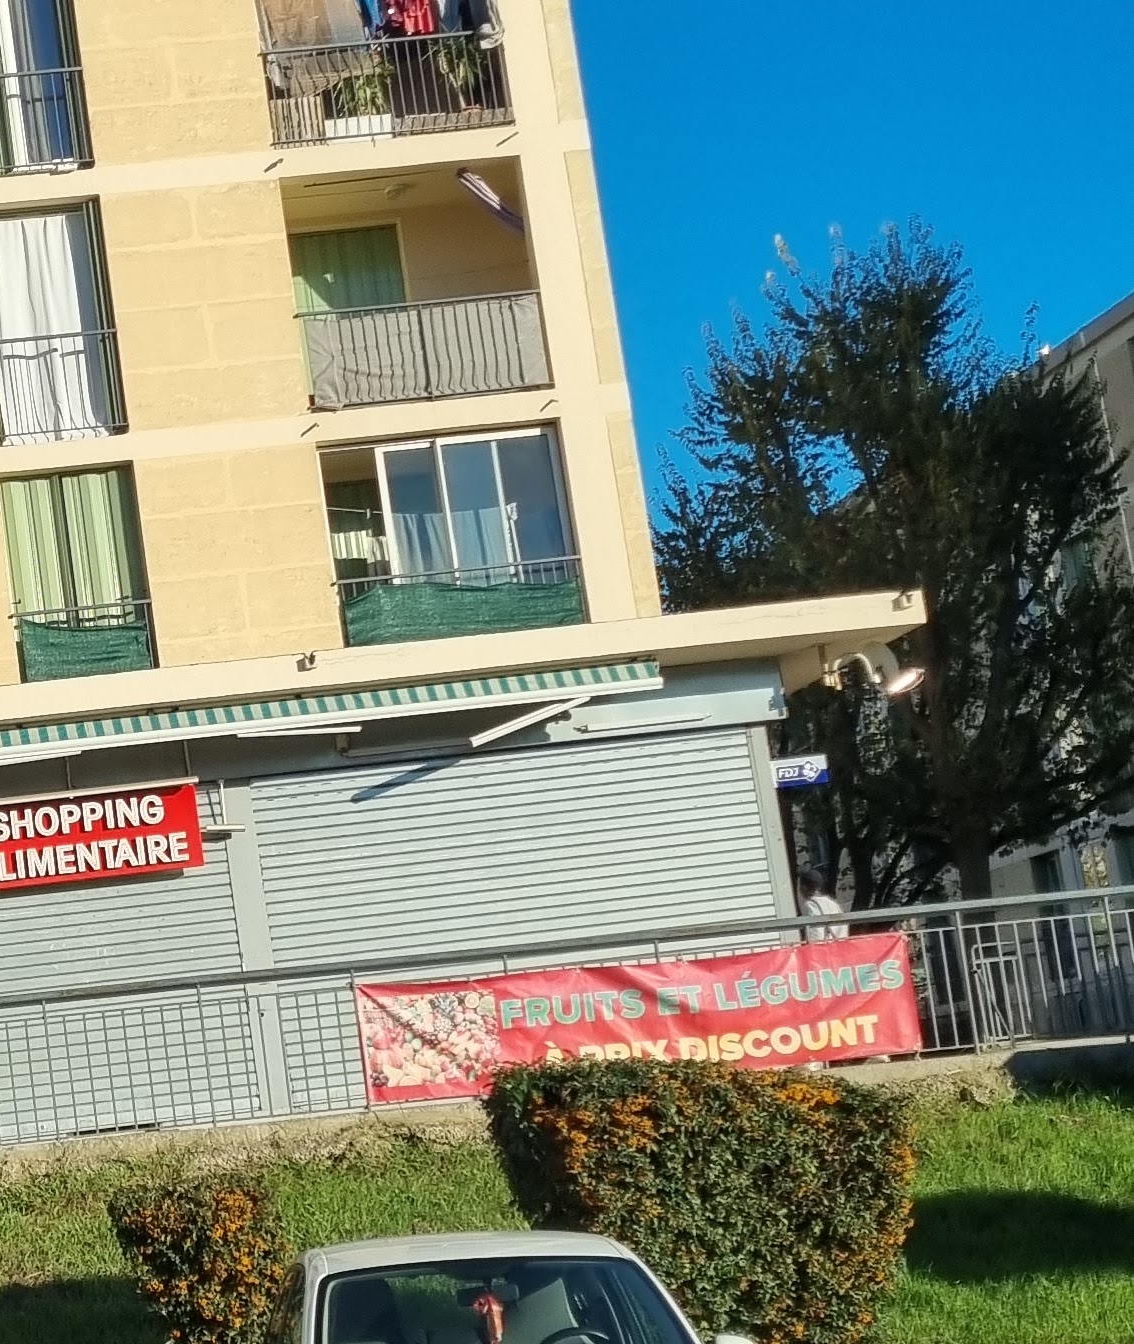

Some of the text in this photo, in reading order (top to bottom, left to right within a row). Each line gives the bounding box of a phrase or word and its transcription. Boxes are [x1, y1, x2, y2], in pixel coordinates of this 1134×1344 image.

[778, 767, 799, 778] FDJ
[500, 959, 904, 1030] FRUITS ET LÉGUMES
[678, 1014, 878, 1062] DISCOUNT
